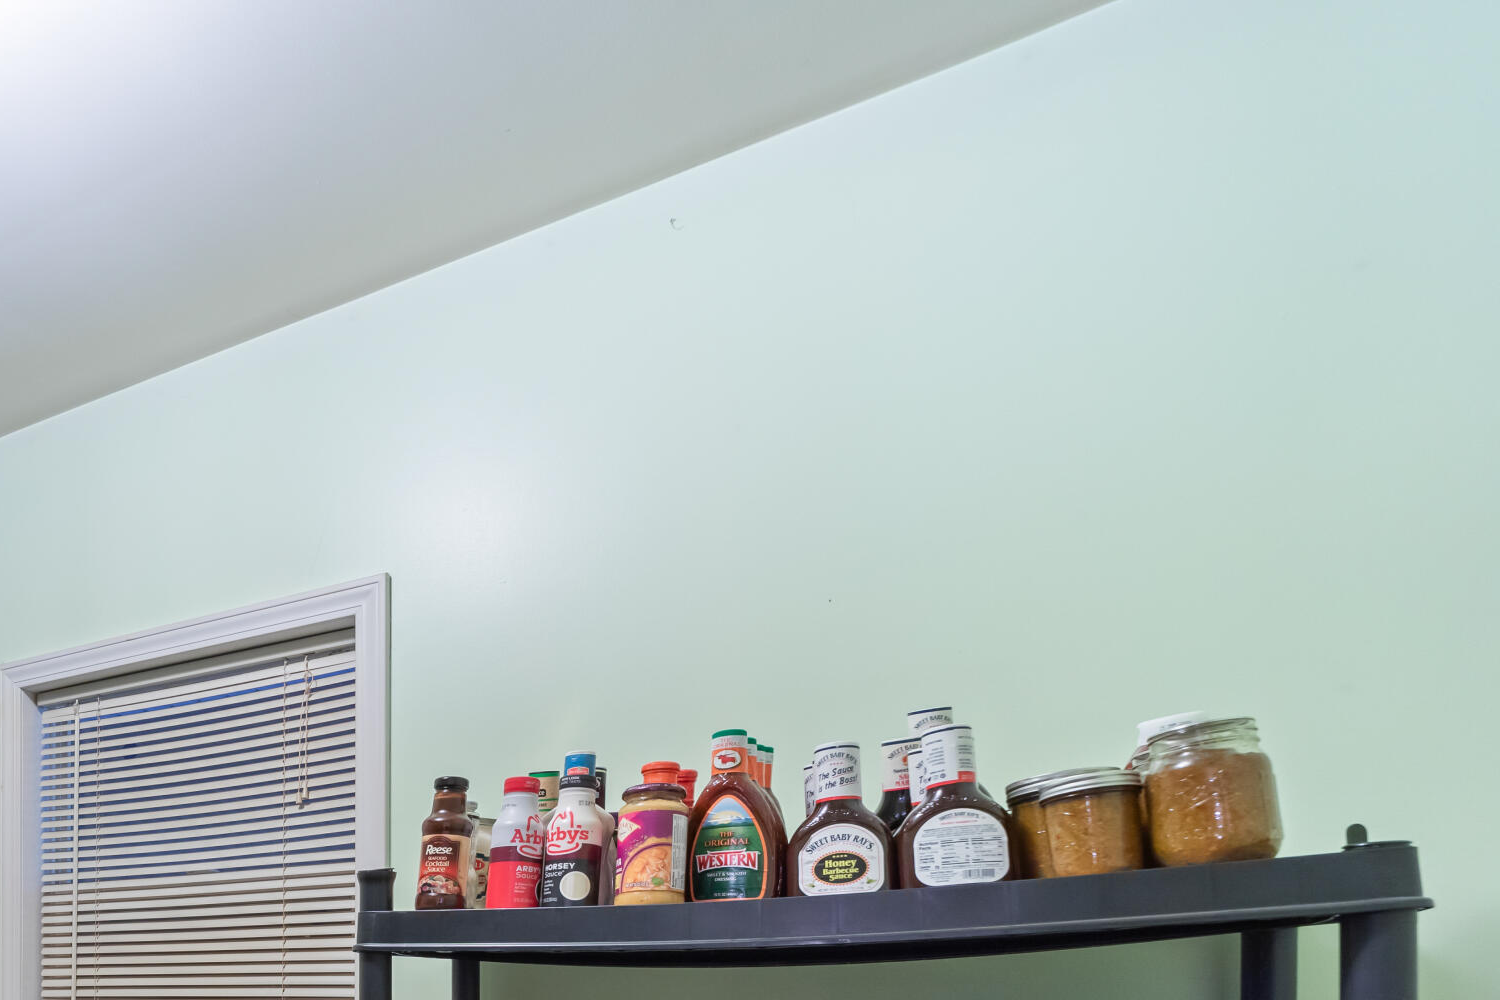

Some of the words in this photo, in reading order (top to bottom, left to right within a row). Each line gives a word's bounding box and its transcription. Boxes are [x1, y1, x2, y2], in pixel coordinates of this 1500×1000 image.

[816, 754, 829, 767] SWEET
[829, 751, 846, 759] BABY
[818, 773, 830, 782] The
[832, 766, 854, 777] Sauce
[824, 781, 837, 790] the
[839, 775, 858, 785] Boss!
[704, 837, 749, 847] ORIGINAL
[805, 837, 829, 854] SWEET
[830, 833, 851, 842] BABY
[853, 834, 875, 850] RAY'S
[425, 845, 452, 855] Reese
[697, 851, 758, 872] WESTERN
[824, 859, 857, 869] Honey
[822, 866, 859, 876] Barbecue
[829, 873, 853, 881] Sauce
